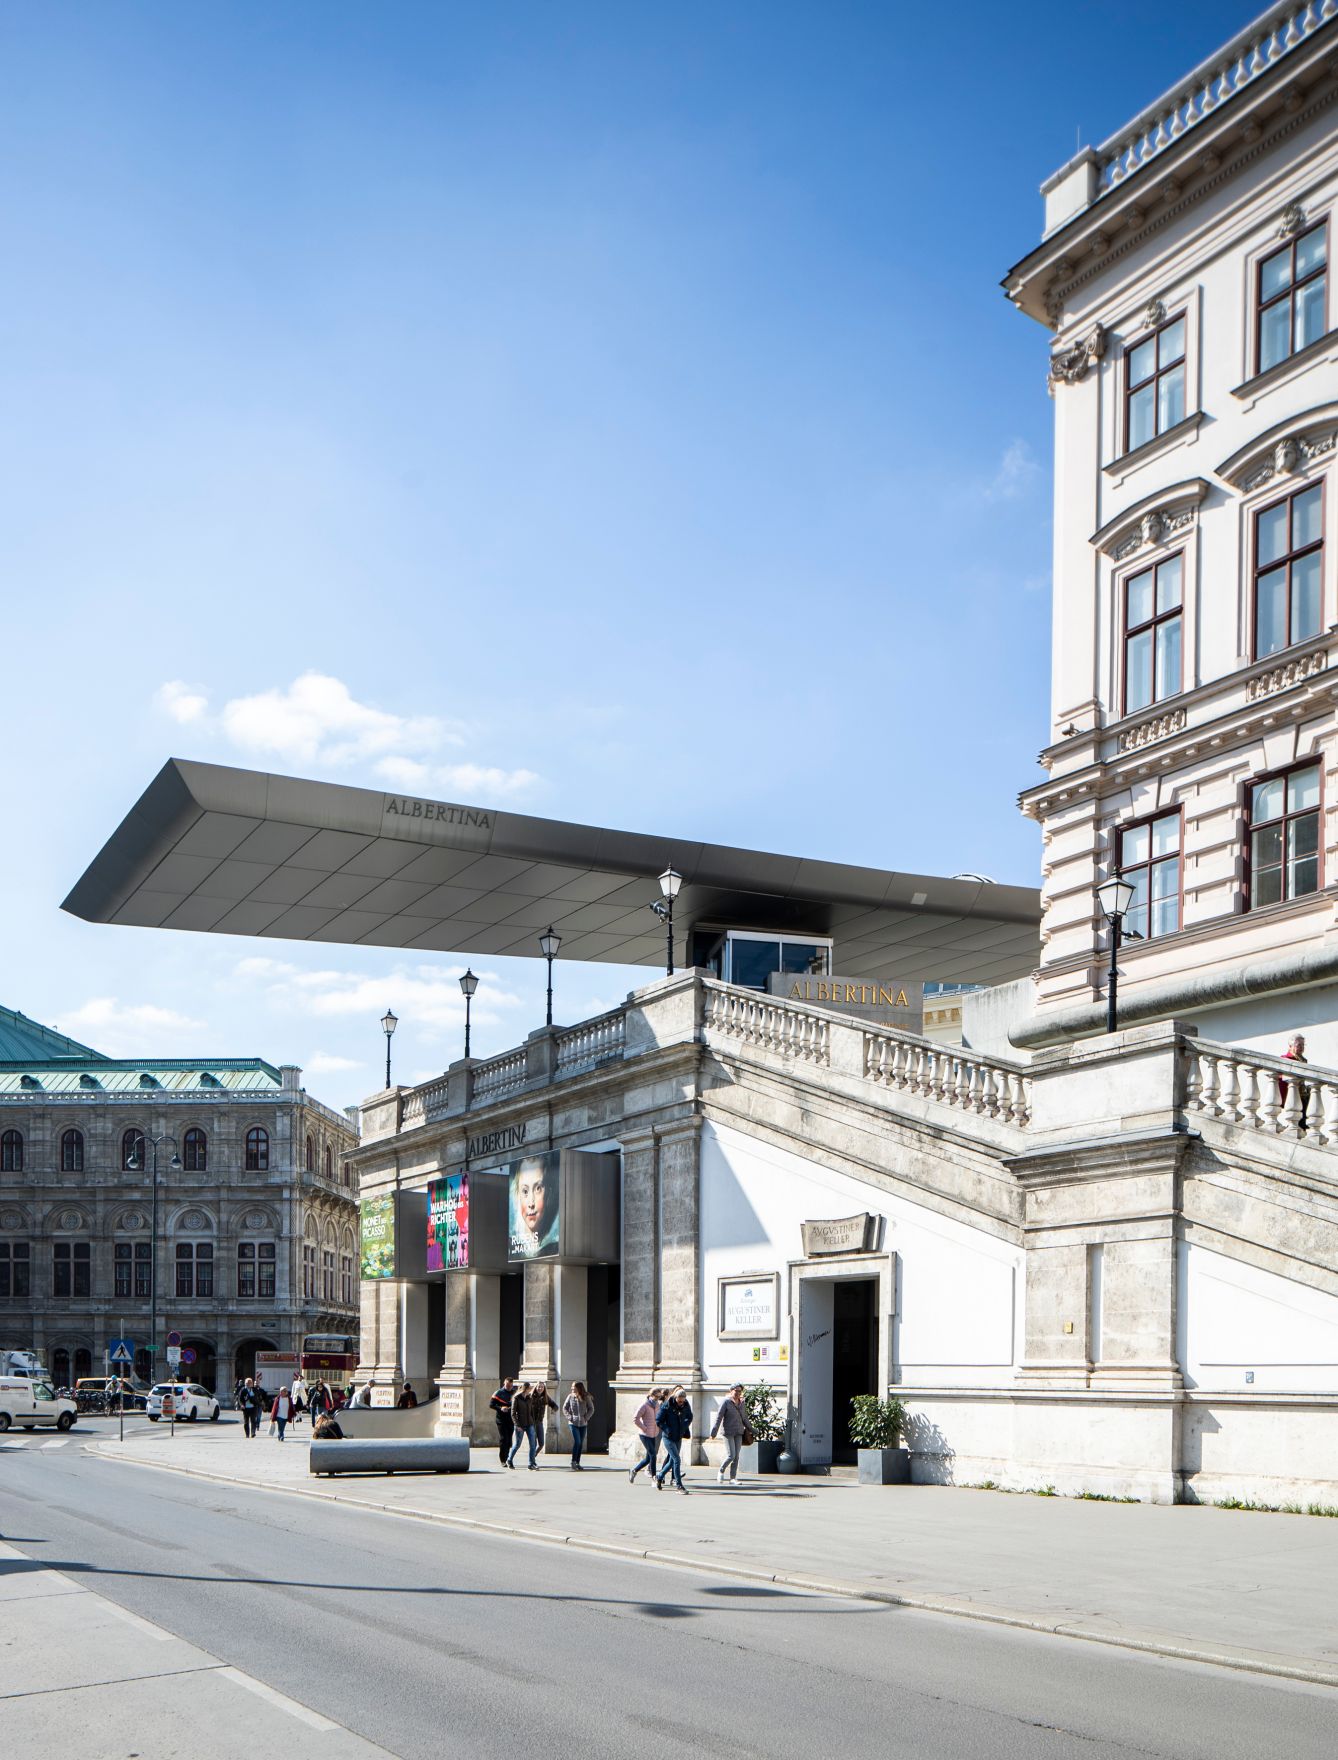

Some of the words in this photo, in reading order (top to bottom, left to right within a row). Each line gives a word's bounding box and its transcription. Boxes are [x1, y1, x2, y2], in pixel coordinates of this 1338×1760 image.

[386, 799, 490, 829] ALBERTINA
[788, 981, 909, 1007] ALBERTINA
[362, 1214, 381, 1228] MONET
[430, 1211, 456, 1225] RICHTER
[362, 1224, 386, 1238] PICASSO
[823, 1234, 849, 1245] KELLER
[728, 1305, 770, 1316] AUGUSTINER
[735, 1315, 762, 1325] KELLER
